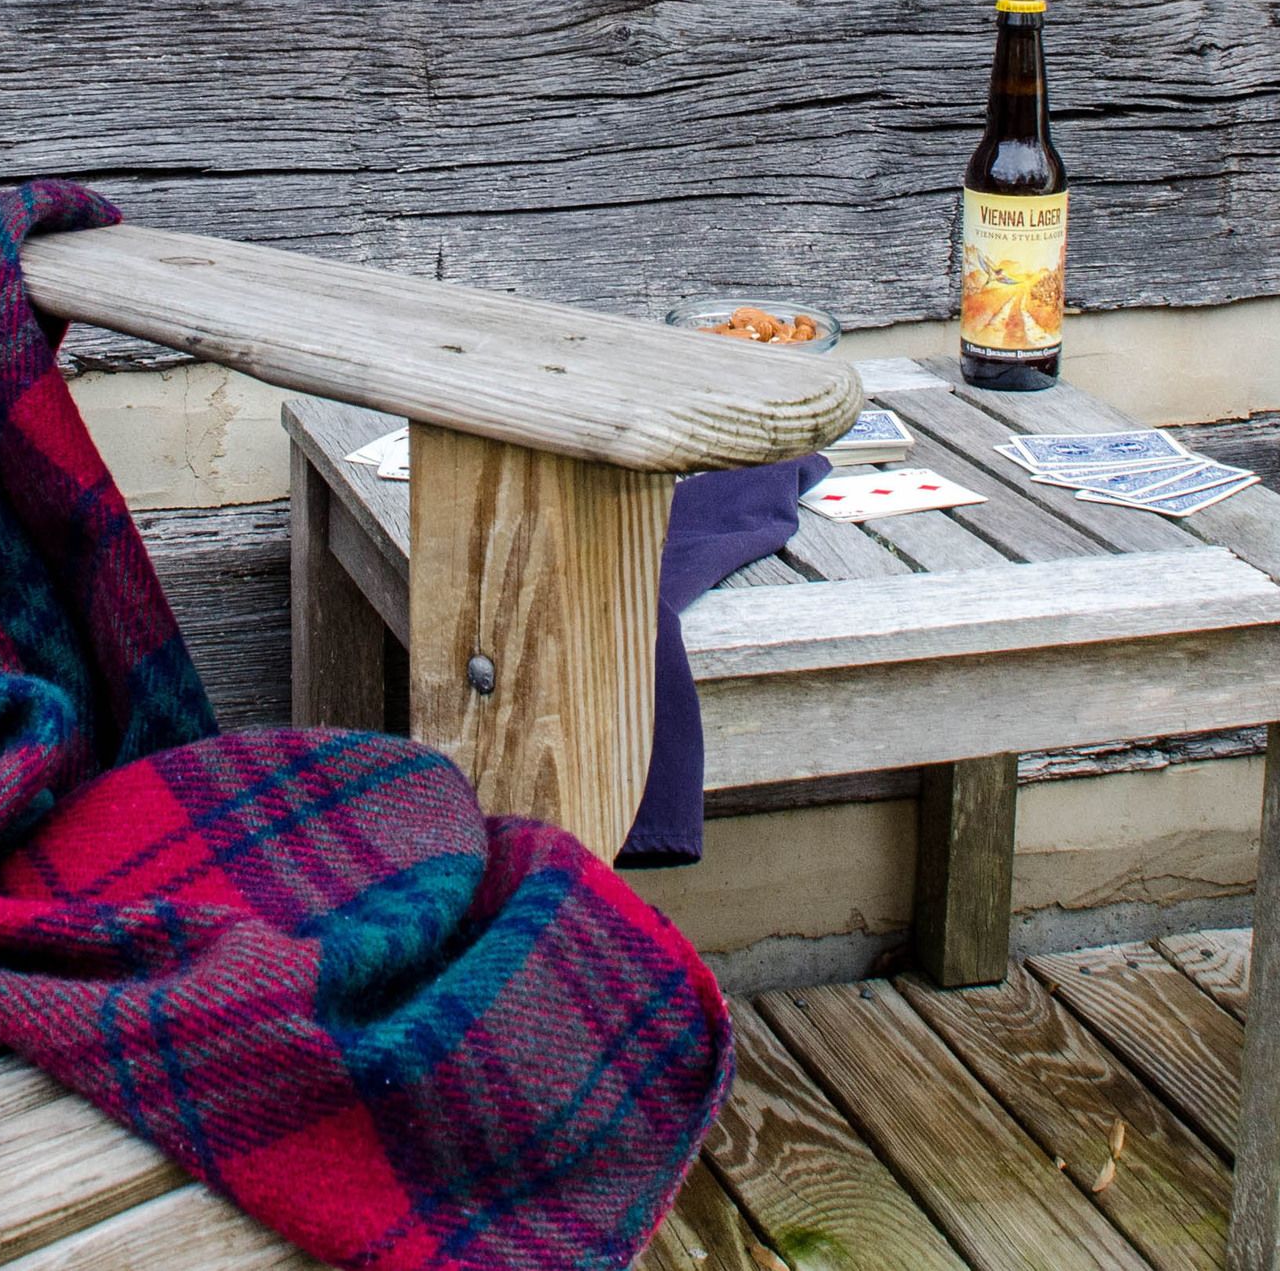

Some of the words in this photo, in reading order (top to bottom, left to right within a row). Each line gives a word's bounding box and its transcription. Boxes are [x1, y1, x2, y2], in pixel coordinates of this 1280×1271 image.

[980, 205, 1024, 227] VIENNA
[1030, 208, 1061, 227] LAGER
[976, 229, 1008, 241] VIENNA
[1011, 233, 1041, 241] STYLE
